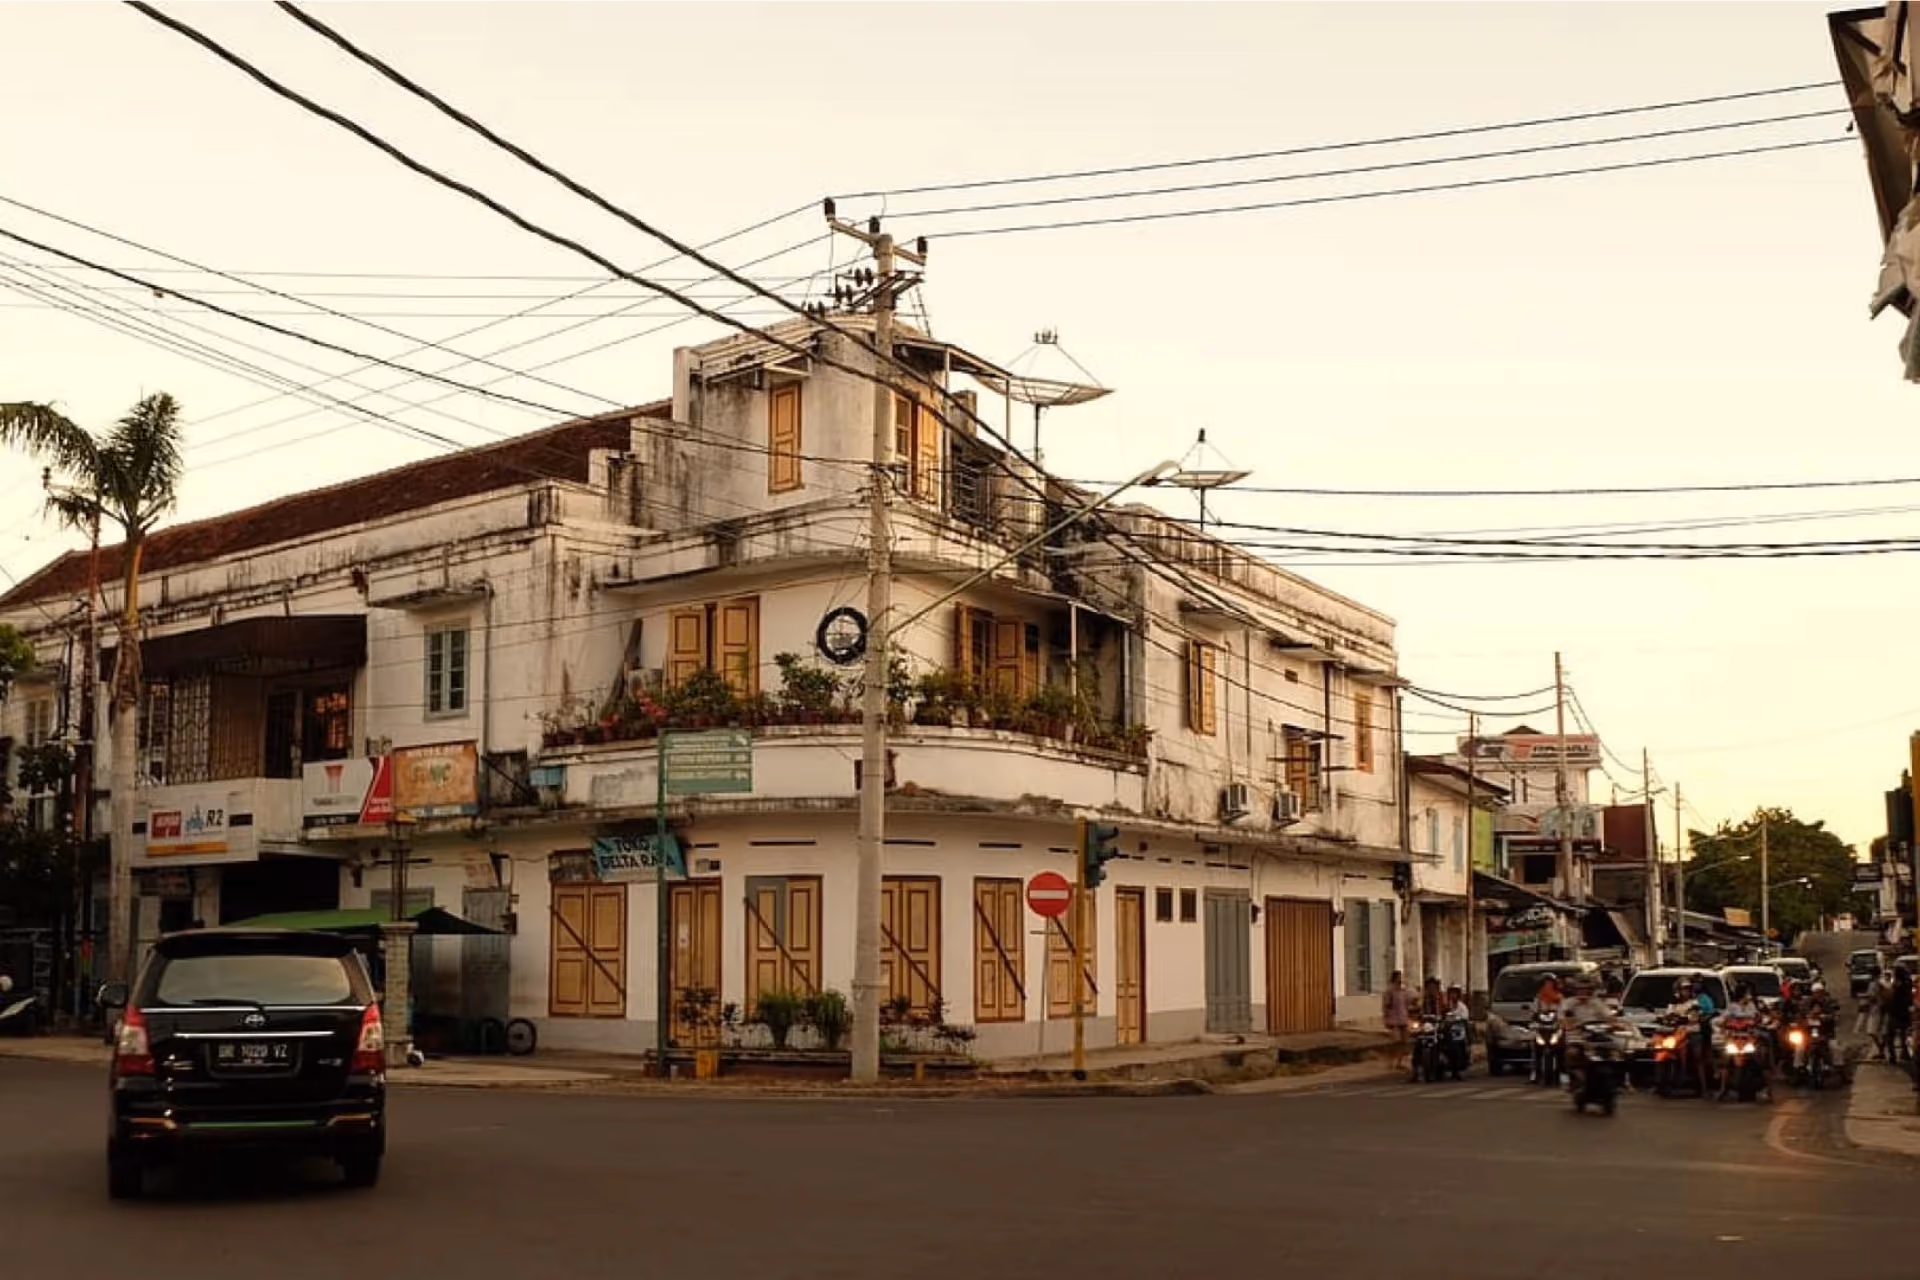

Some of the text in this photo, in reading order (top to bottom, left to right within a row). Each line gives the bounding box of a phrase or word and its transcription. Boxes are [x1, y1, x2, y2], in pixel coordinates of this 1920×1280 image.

[206, 808, 224, 828] R2
[600, 853, 676, 869] DELTA RAA
